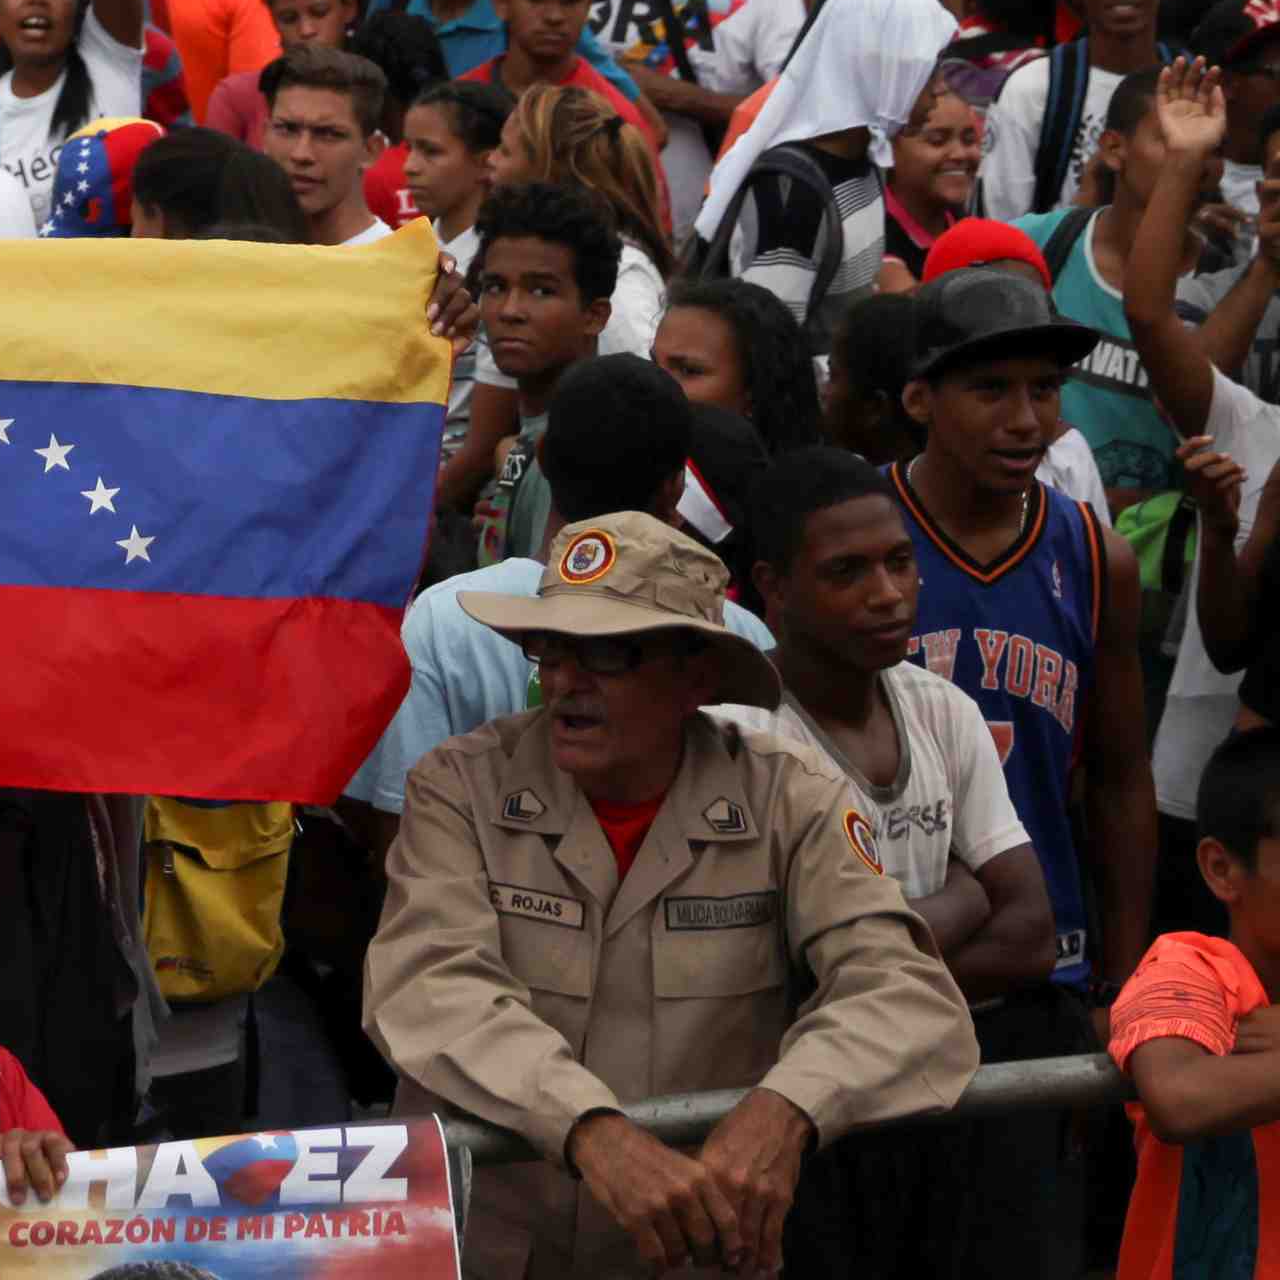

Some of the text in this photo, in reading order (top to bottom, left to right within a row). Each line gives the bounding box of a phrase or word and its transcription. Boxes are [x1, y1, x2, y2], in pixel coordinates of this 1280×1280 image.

[973, 627, 1078, 735] YORK
[511, 893, 563, 918] ROJAS
[8, 1209, 408, 1248] CORAZÓN DE MI PATRIA
